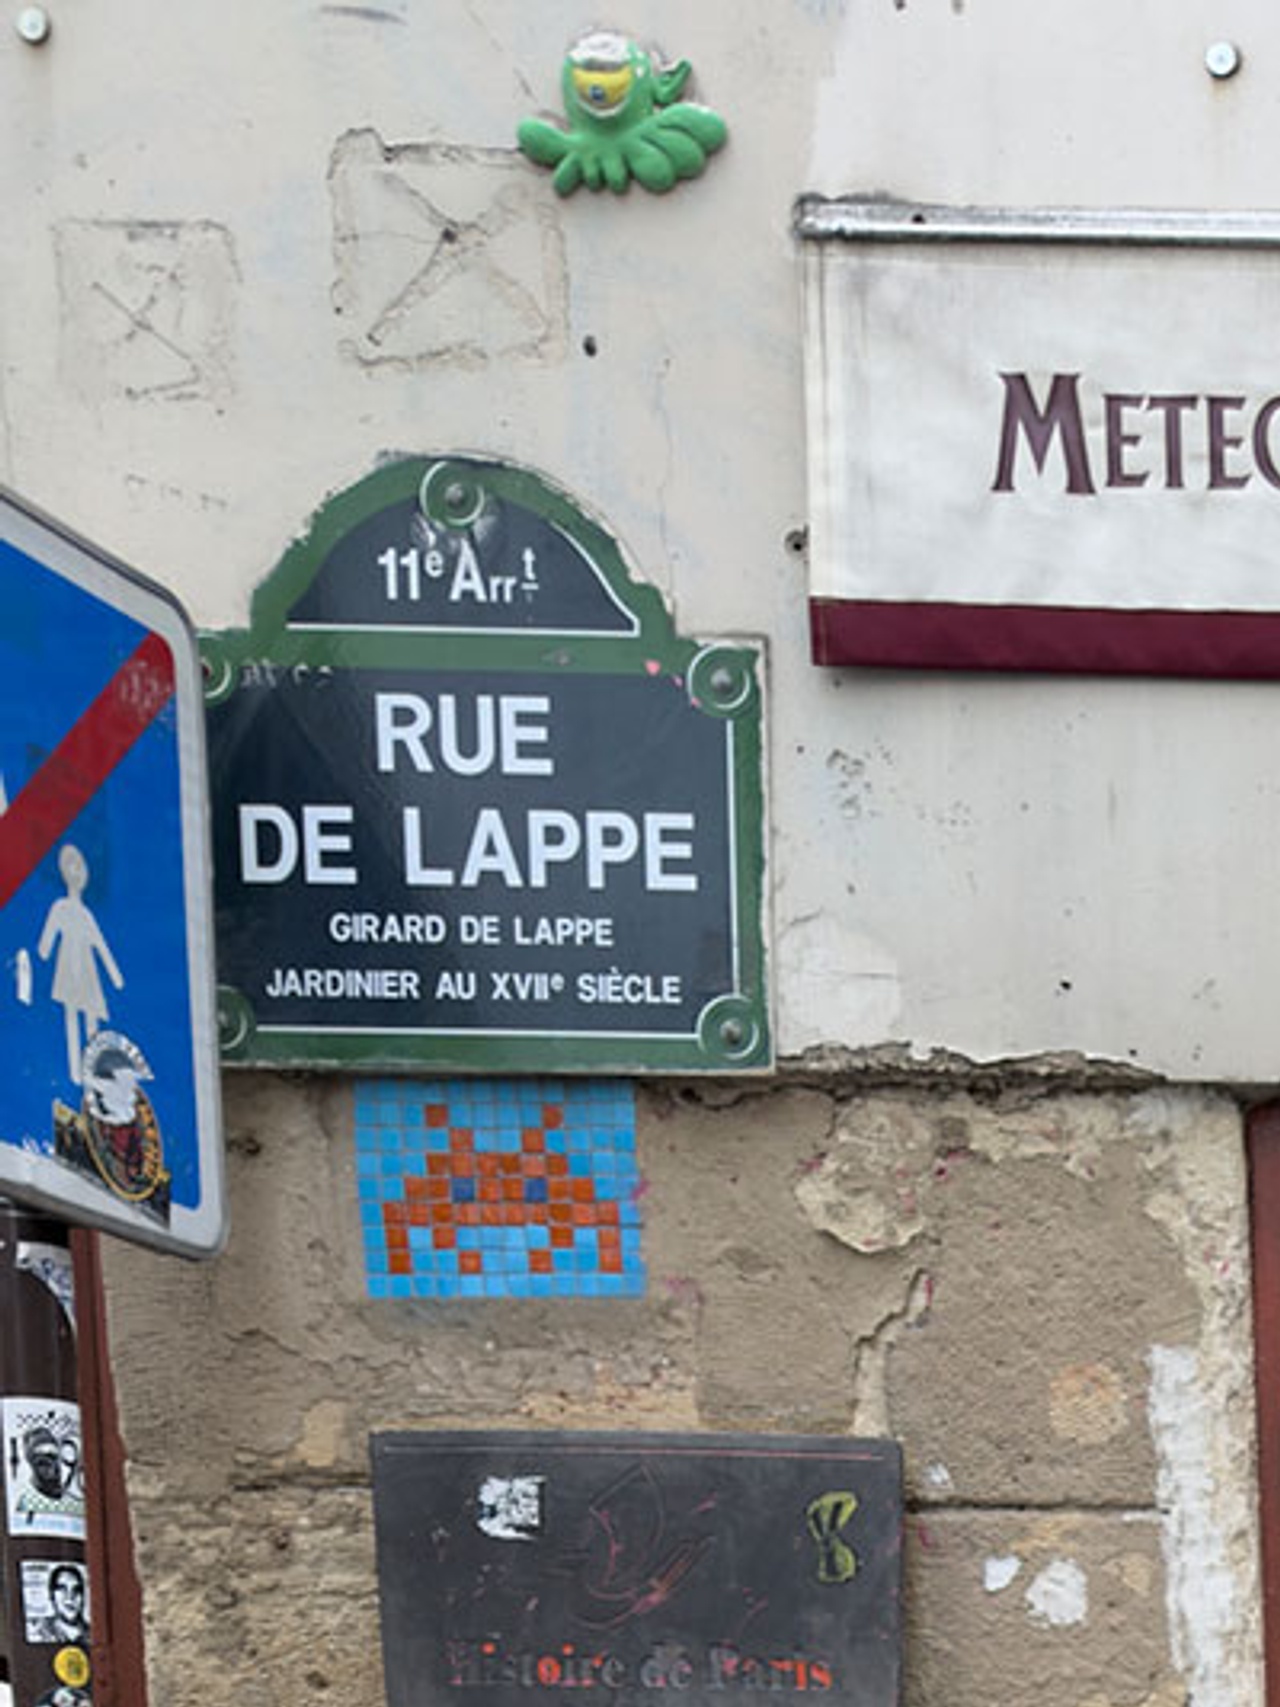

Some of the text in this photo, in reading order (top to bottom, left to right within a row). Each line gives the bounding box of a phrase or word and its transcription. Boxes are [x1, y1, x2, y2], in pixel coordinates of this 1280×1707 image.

[378, 546, 445, 601] 11e
[375, 692, 554, 775] RUE
[239, 804, 698, 892] DE LAPPE
[329, 912, 615, 947] GIRARD DE LAPPE
[266, 969, 420, 1000] JARDINIER
[436, 972, 476, 1001] AU
[577, 966, 682, 1005] SIÈCLE
